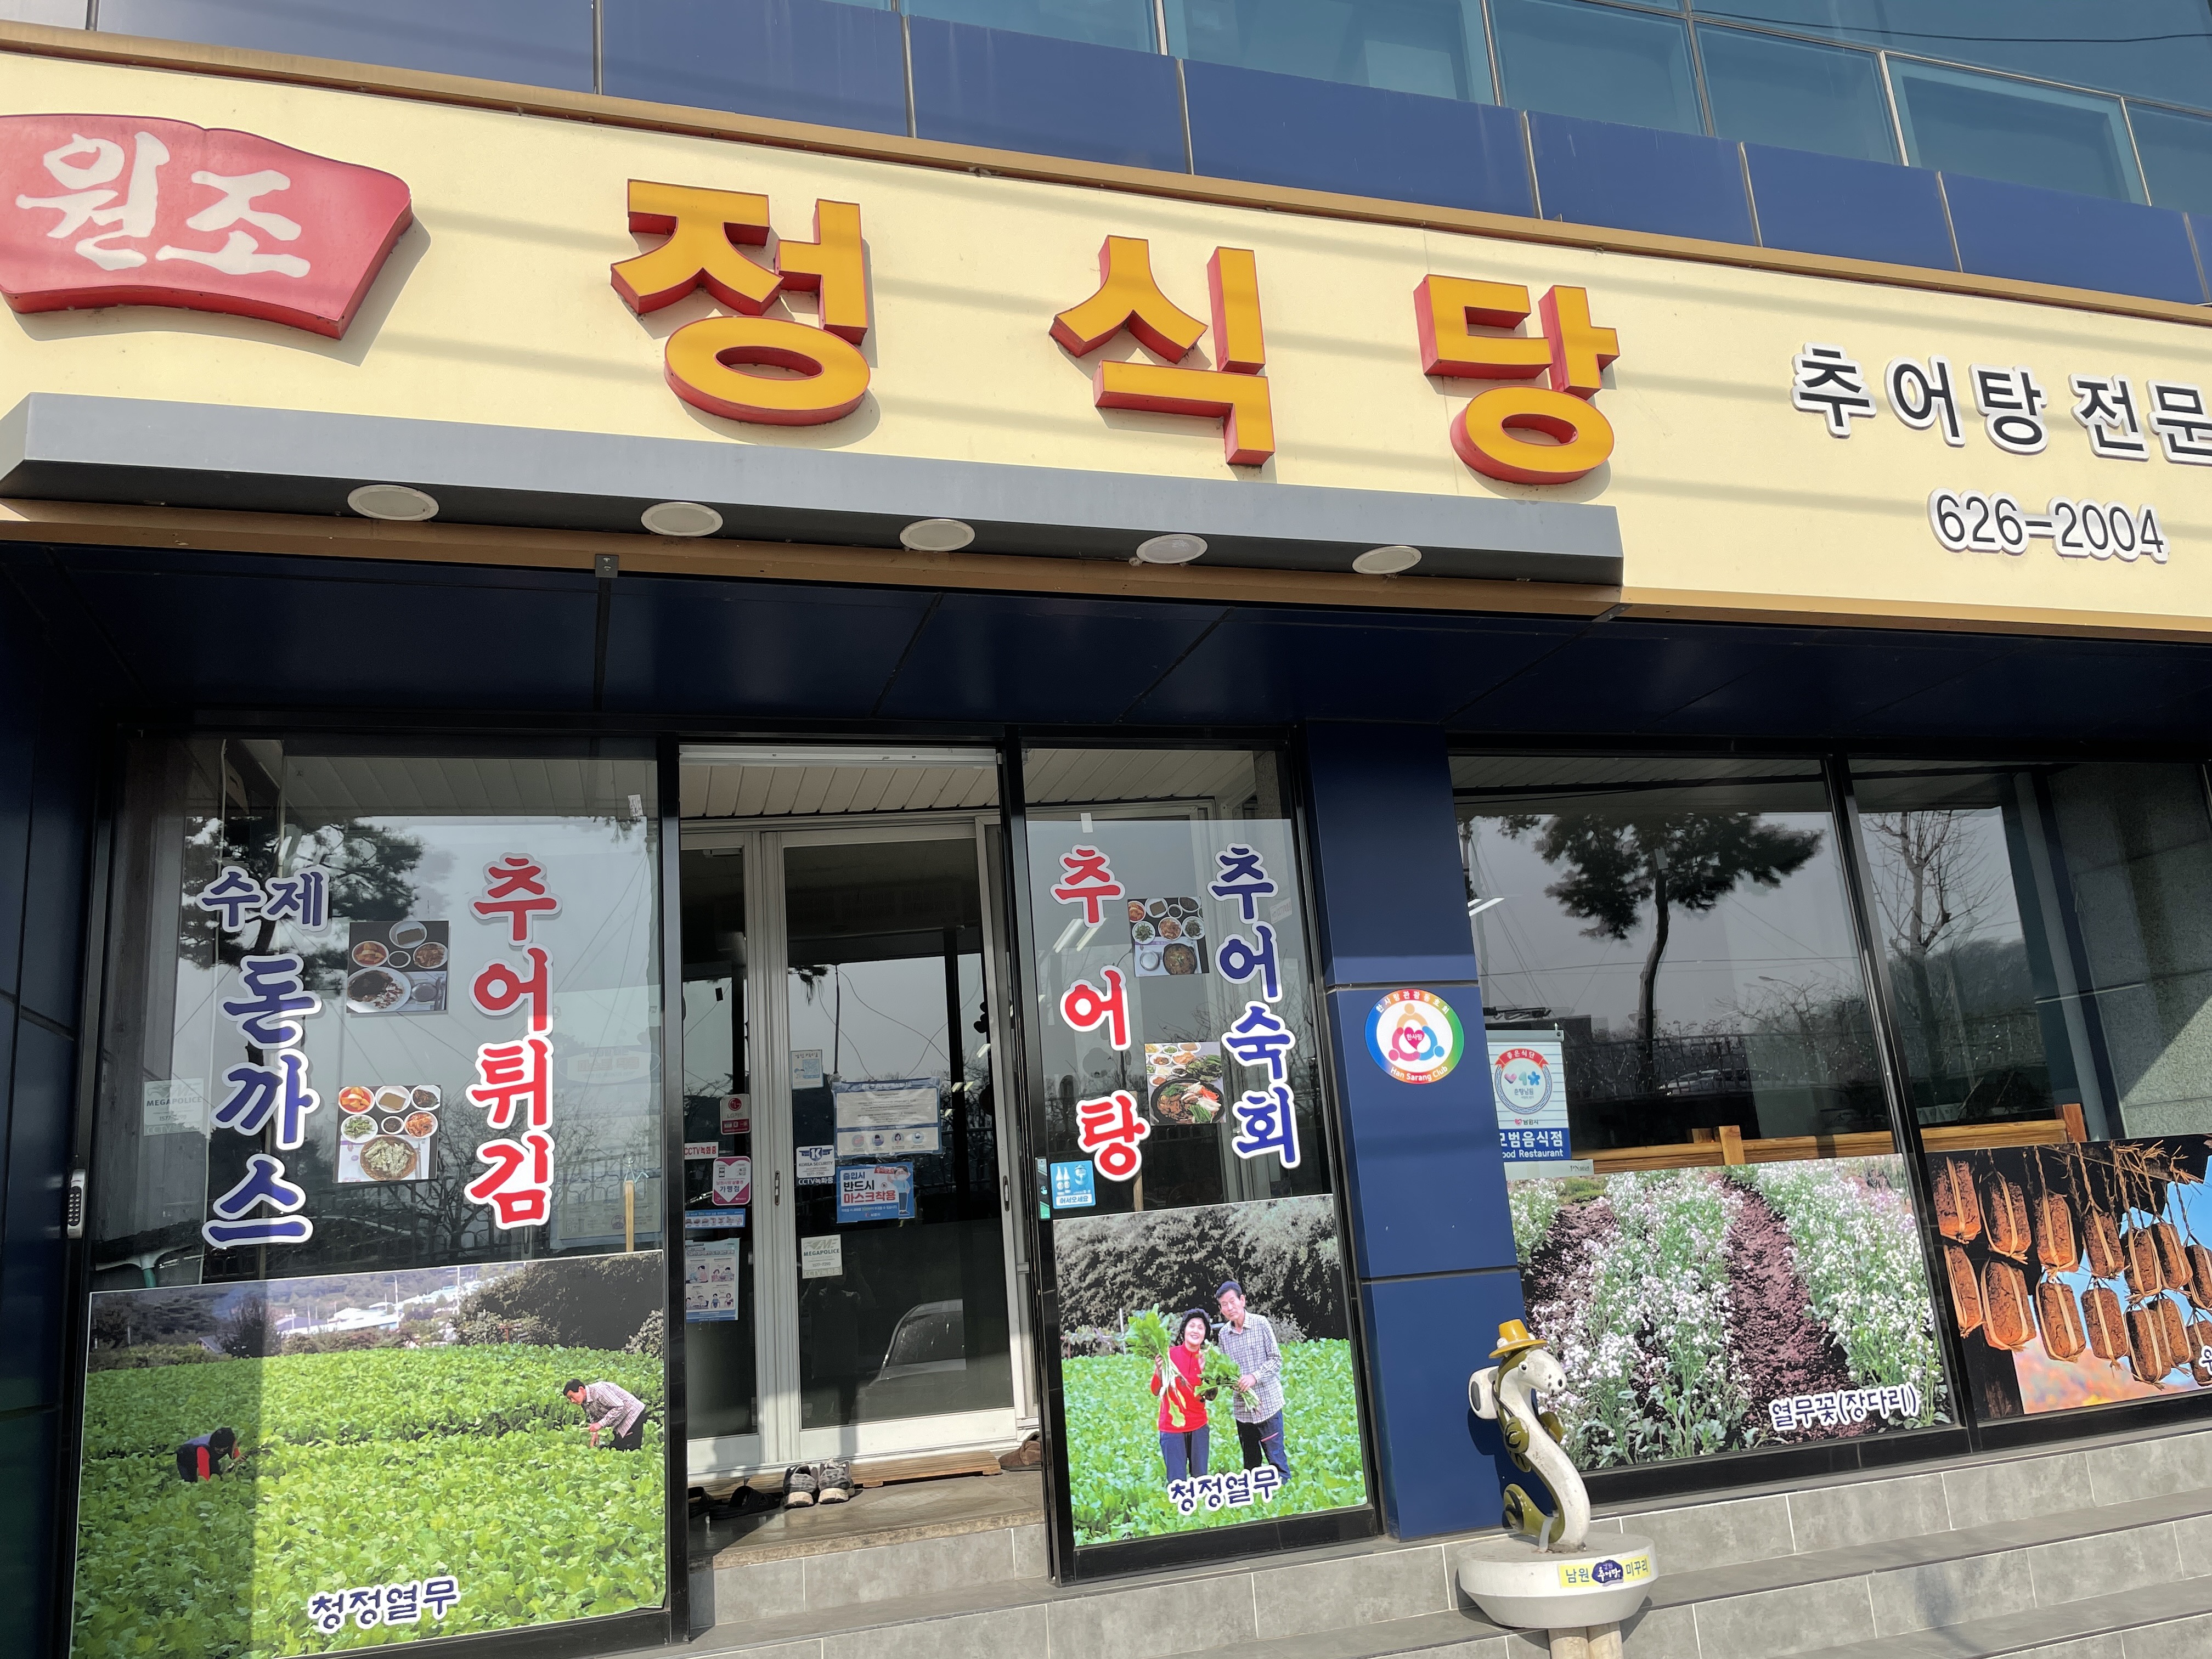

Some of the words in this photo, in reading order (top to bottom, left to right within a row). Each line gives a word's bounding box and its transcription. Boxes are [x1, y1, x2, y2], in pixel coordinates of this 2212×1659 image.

[15, 131, 312, 279] 원조
[610, 178, 1621, 486] 정식당
[1798, 346, 2045, 448] 추어탕
[2074, 374, 2212, 458] 전문
[1936, 494, 2165, 554] 626-2004
[201, 871, 324, 928] 수제
[1054, 848, 1147, 1176] 추어탕
[1210, 847, 1296, 1164] 추어숙회
[469, 856, 557, 1225] 추어튀김
[1390, 1066, 1405, 1079] Han
[1406, 1073, 1432, 1082] Sarang
[1432, 1065, 1448, 1078] Club
[146, 1097, 202, 1107] MEGAPOLICE
[207, 958, 317, 1243] 돈까스
[1502, 1149, 1516, 1158] ood
[1519, 1148, 1564, 1158] Restaurant
[843, 1171, 865, 1180] 출입시
[843, 1180, 875, 1192] 반드시
[844, 1190, 896, 1204] 마스크착용
[1059, 1195, 1088, 1204] 어서오세요
[803, 1248, 840, 1256] MEGAPOLICE
[1771, 1384, 1917, 1427] 열무꽃(장다리)
[1170, 1468, 1279, 1512] 청정열무
[1566, 1567, 1590, 1583] 남원
[1626, 1558, 1649, 1576] 미꾸리
[312, 1579, 457, 1629] 청정열무
